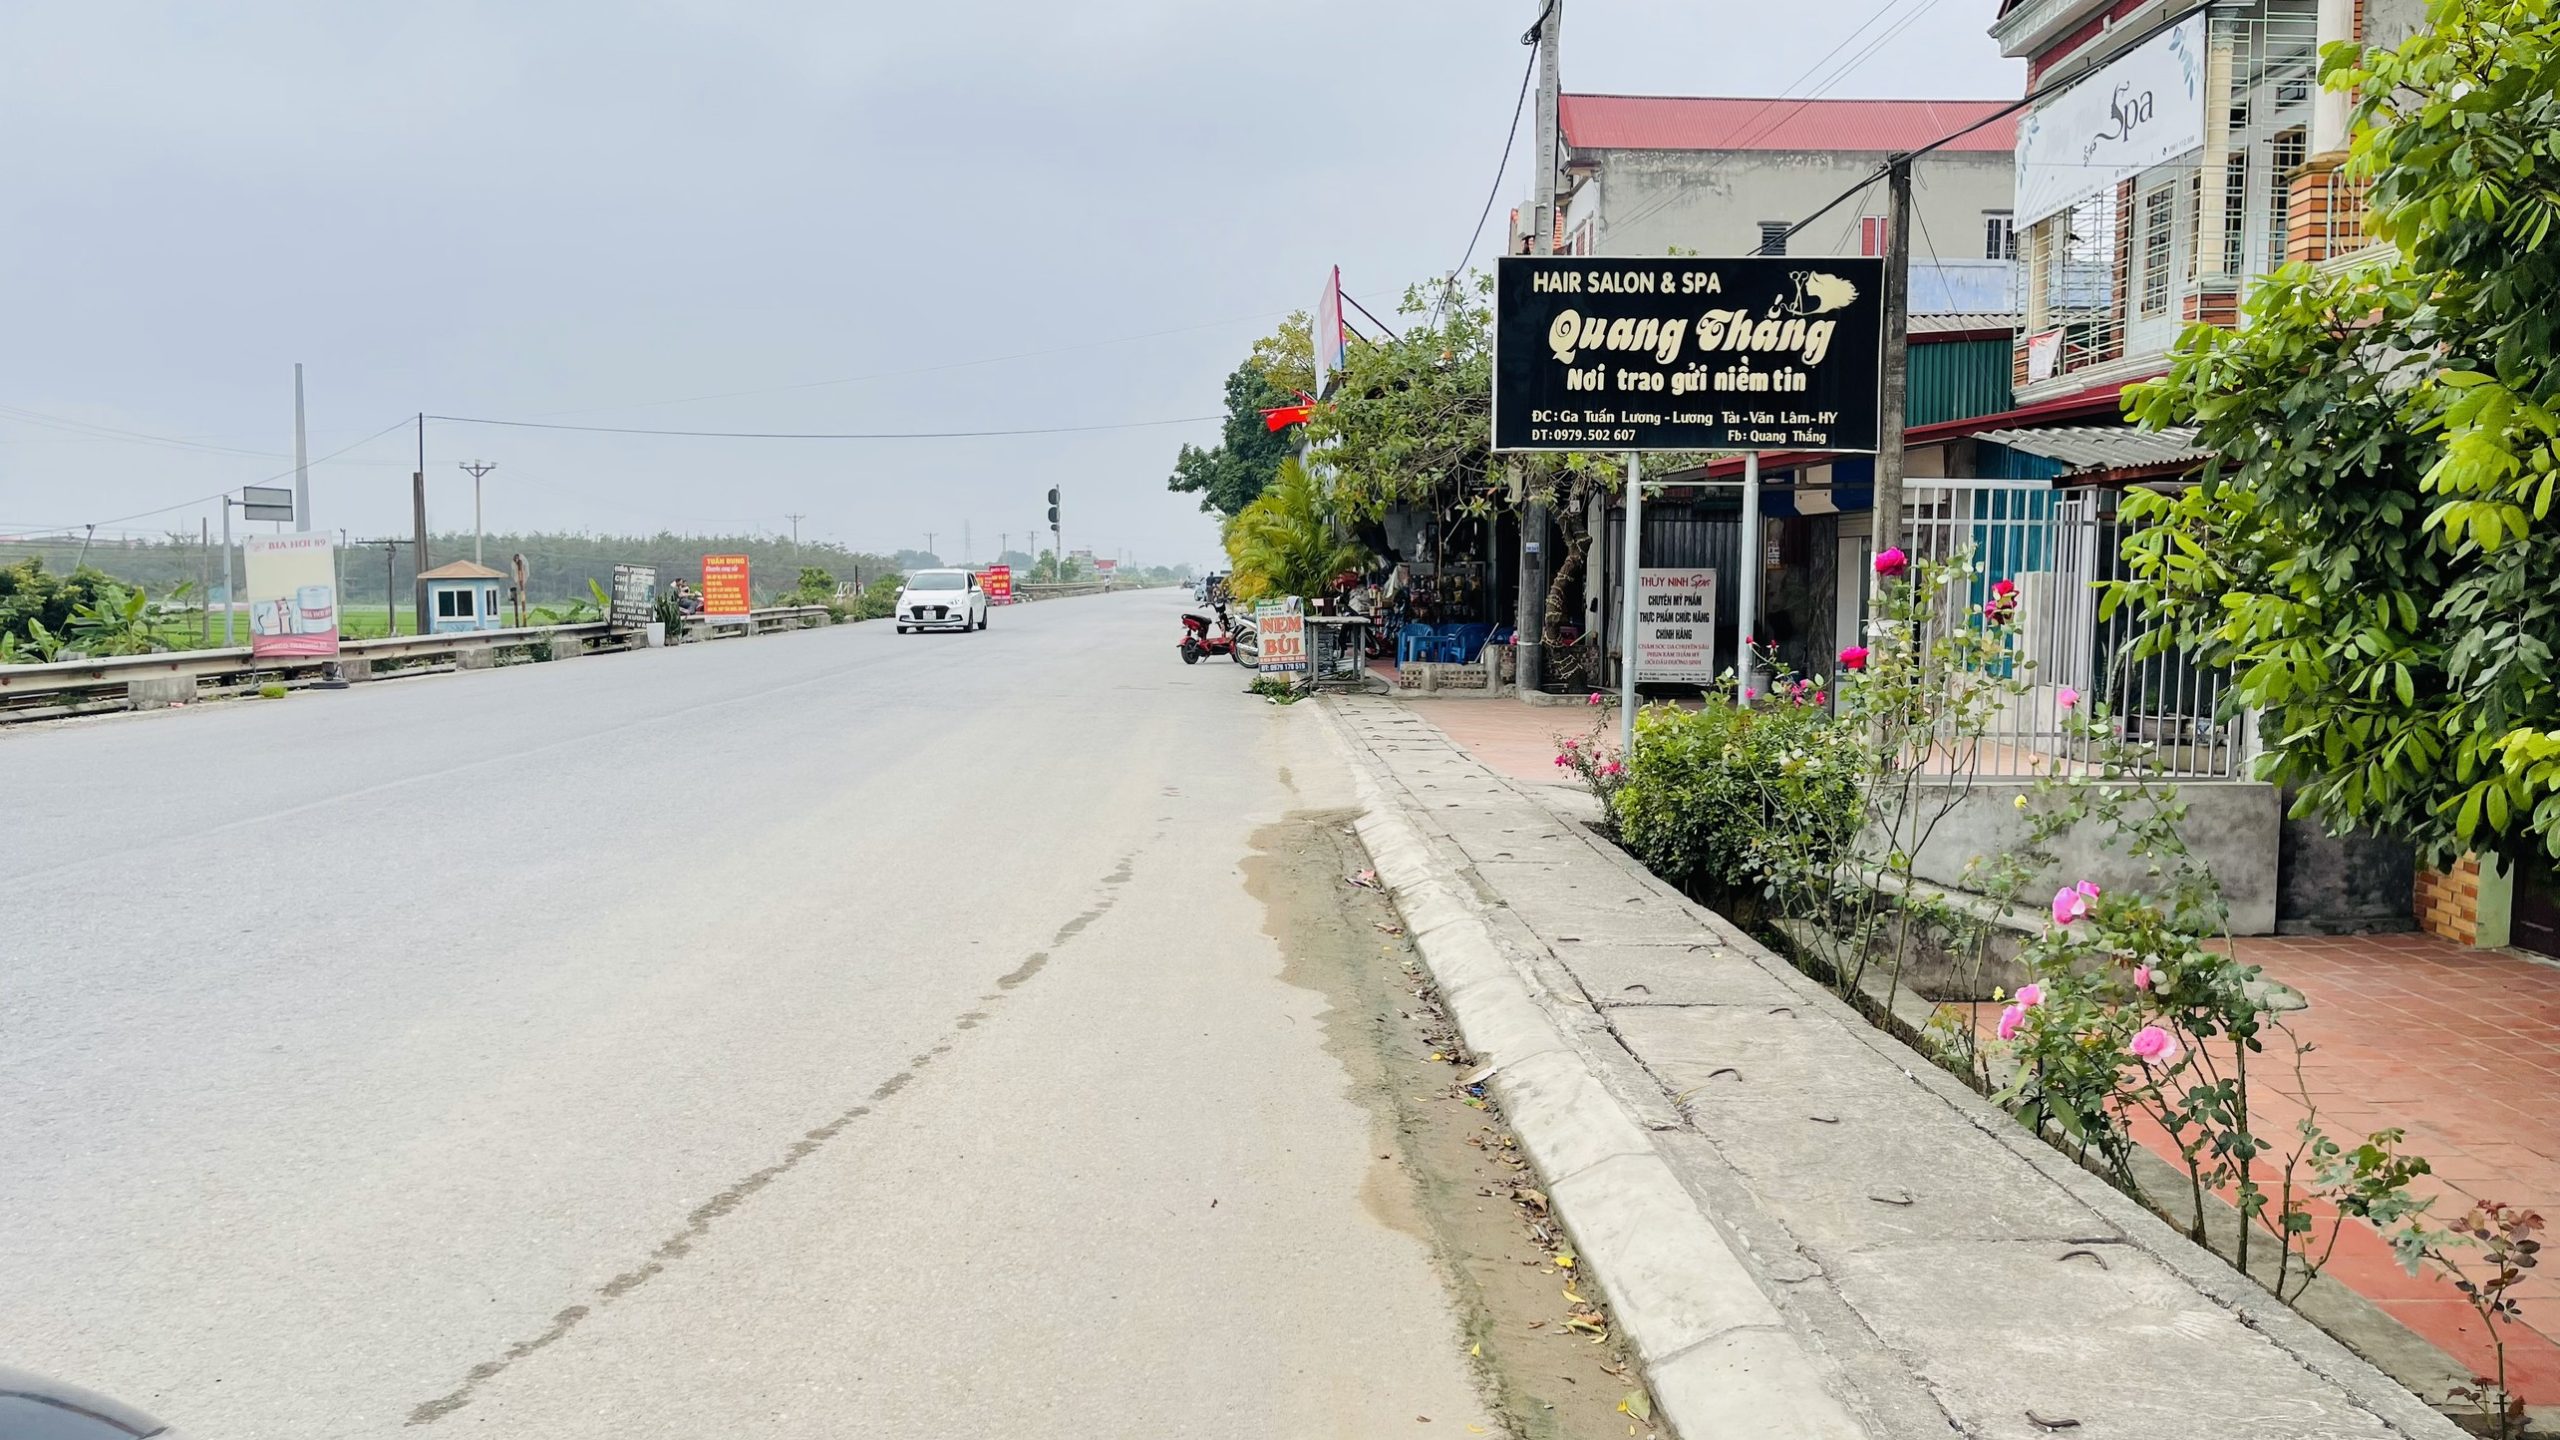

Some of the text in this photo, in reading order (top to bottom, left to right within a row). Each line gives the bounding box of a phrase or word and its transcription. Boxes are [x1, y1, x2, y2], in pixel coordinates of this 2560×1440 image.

[2090, 80, 2153, 150] Spa
[1533, 271, 1721, 294] HAIR SALON & SPA
[1549, 294, 1836, 366] Quang Thắng
[1566, 356, 1807, 396] Nơi trao gửi niềm tin
[1584, 408, 1615, 423] Tuấn
[1622, 410, 1661, 426] Lương
[1613, 429, 1636, 441] 607
[1749, 430, 1787, 444] Quang
[1792, 427, 1827, 445] Thắng
[1667, 576, 1689, 587] NINH
[1648, 593, 1672, 606] CHUYÊN
[1260, 615, 1303, 634] NEM
